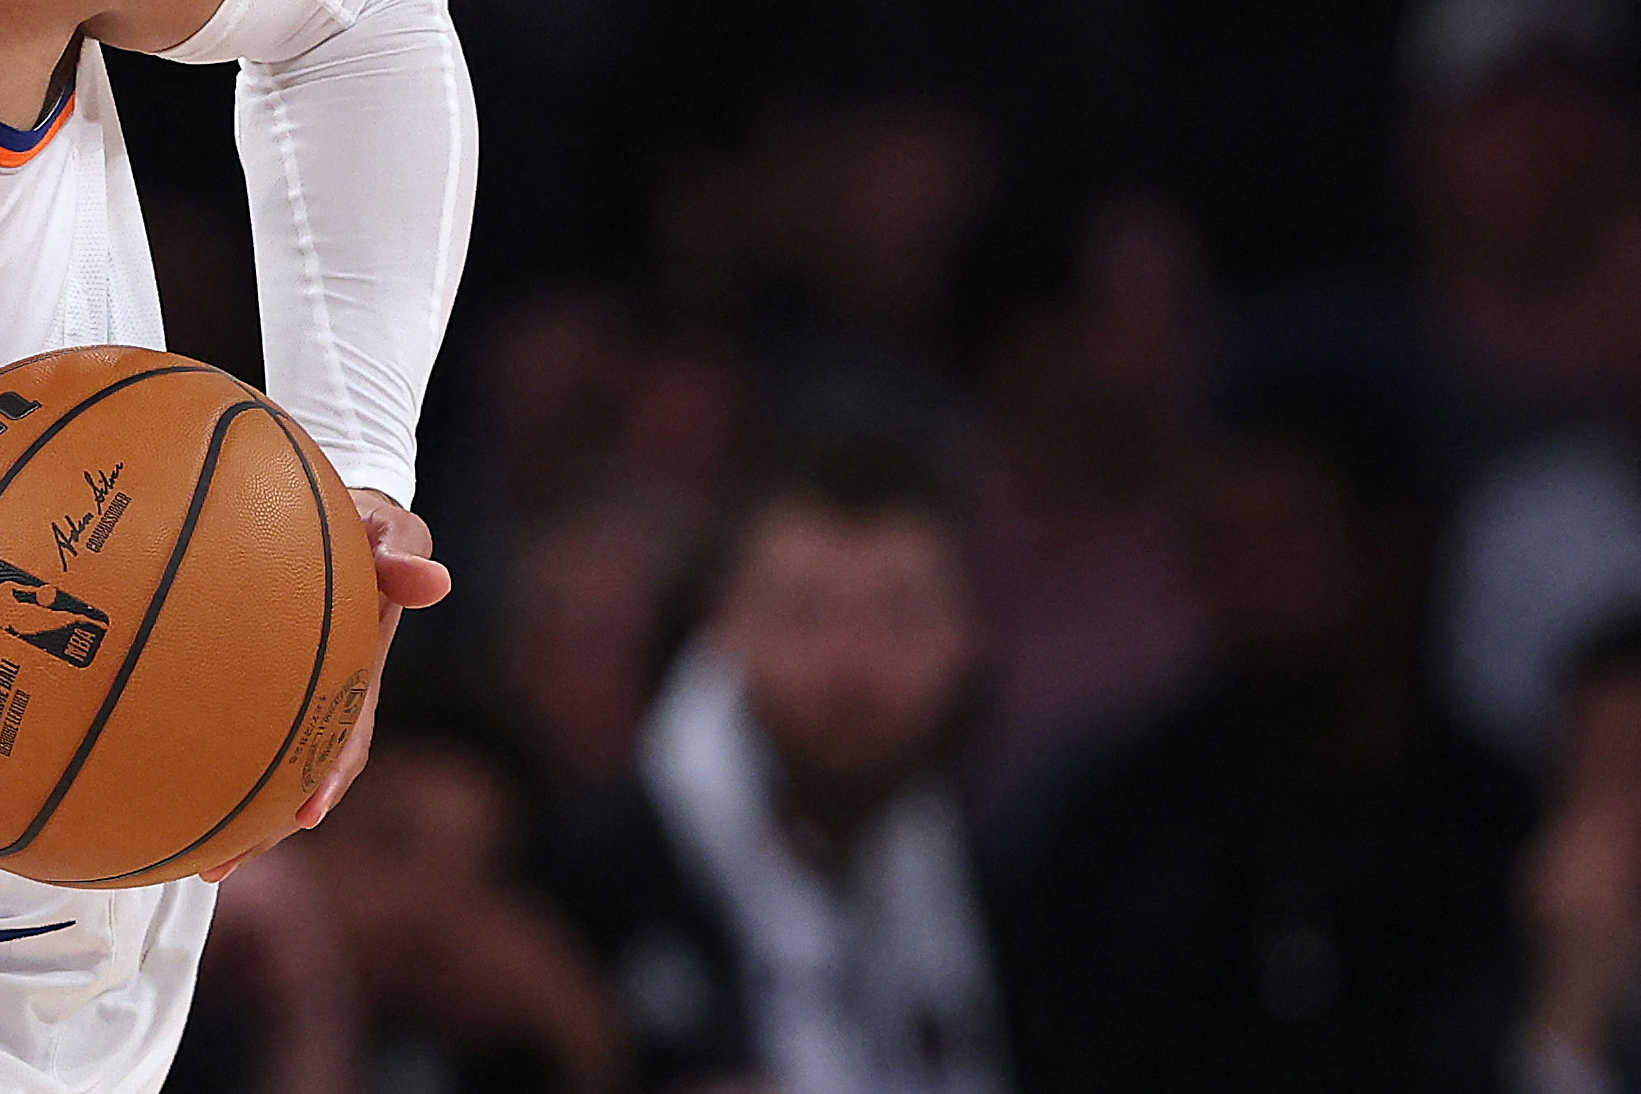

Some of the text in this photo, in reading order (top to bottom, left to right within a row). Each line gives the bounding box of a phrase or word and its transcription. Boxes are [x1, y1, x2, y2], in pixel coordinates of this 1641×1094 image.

[85, 492, 132, 554] COMMISSIONER
[63, 627, 97, 662] NBA
[5, 689, 31, 726] LEATHER
